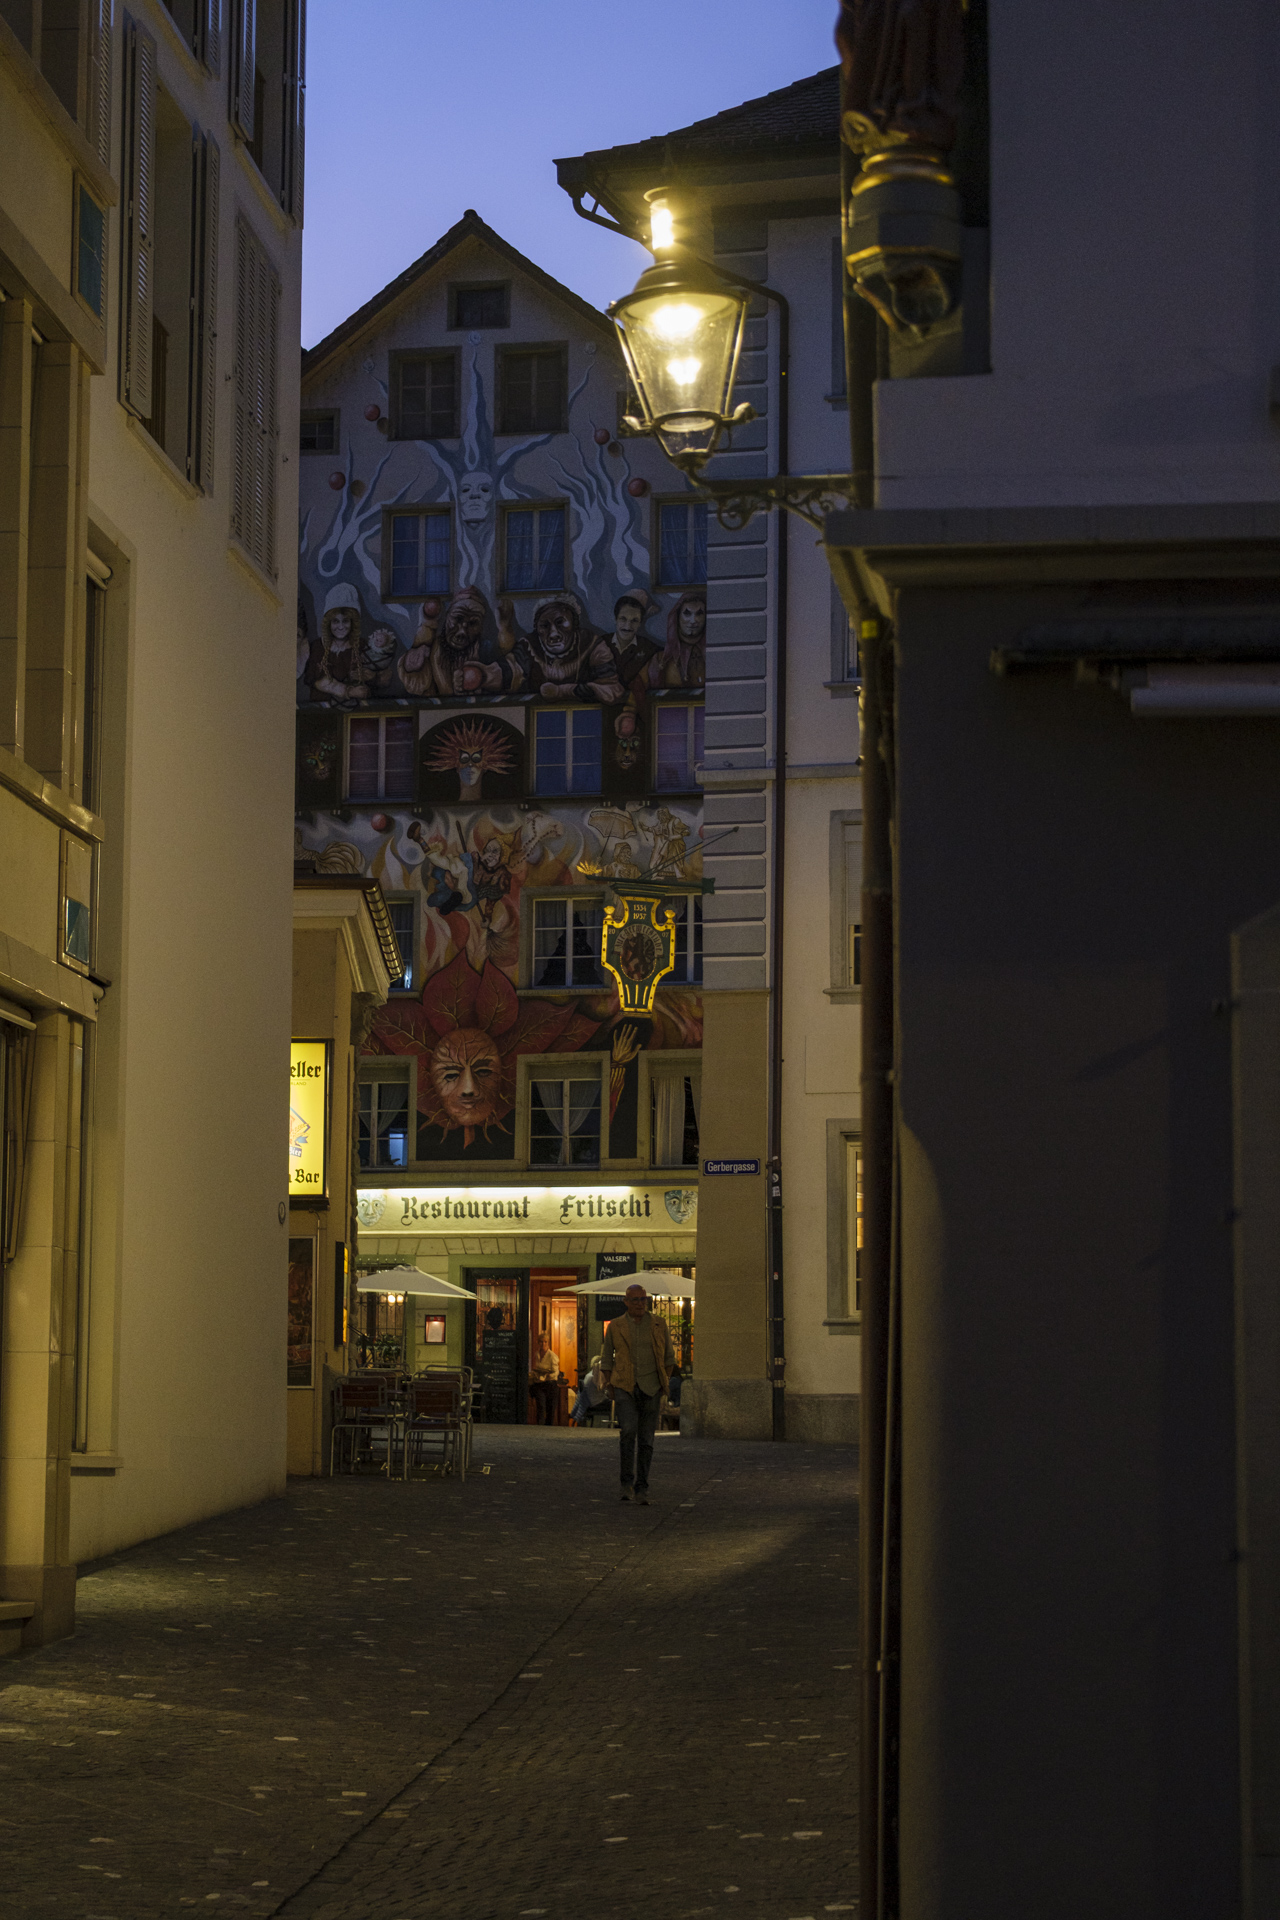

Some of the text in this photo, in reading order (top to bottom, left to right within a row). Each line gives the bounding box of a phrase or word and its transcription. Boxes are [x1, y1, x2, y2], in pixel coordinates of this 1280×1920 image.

[707, 1161, 756, 1174] Gerbergasse
[295, 1168, 320, 1183] Bar
[400, 1193, 652, 1227] Restaurant Fritschi
